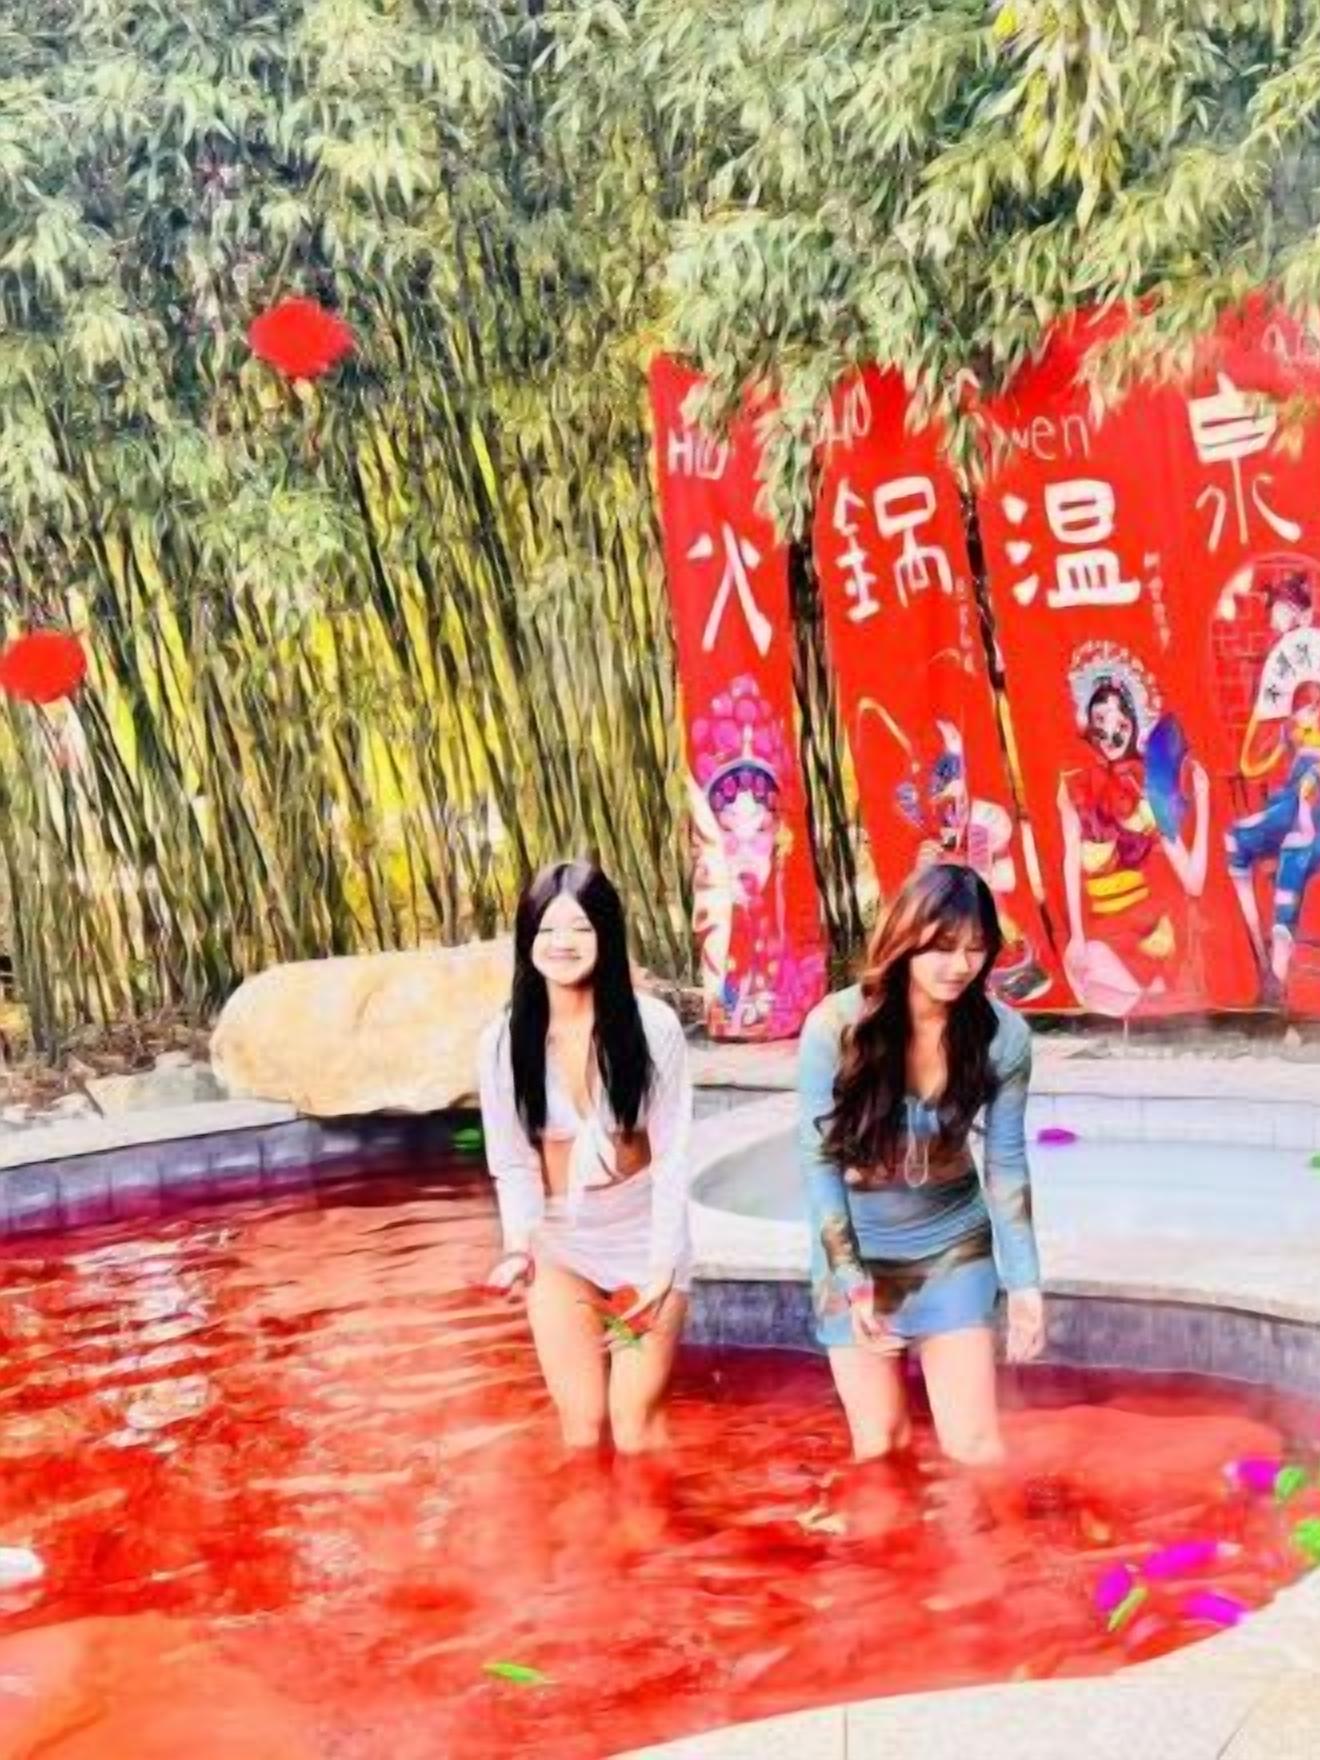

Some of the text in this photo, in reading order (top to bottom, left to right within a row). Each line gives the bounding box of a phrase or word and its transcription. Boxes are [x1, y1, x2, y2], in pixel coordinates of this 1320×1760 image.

[1188, 370, 1302, 553] 泉
[687, 521, 773, 658] 火
[1001, 478, 1142, 609] 温
